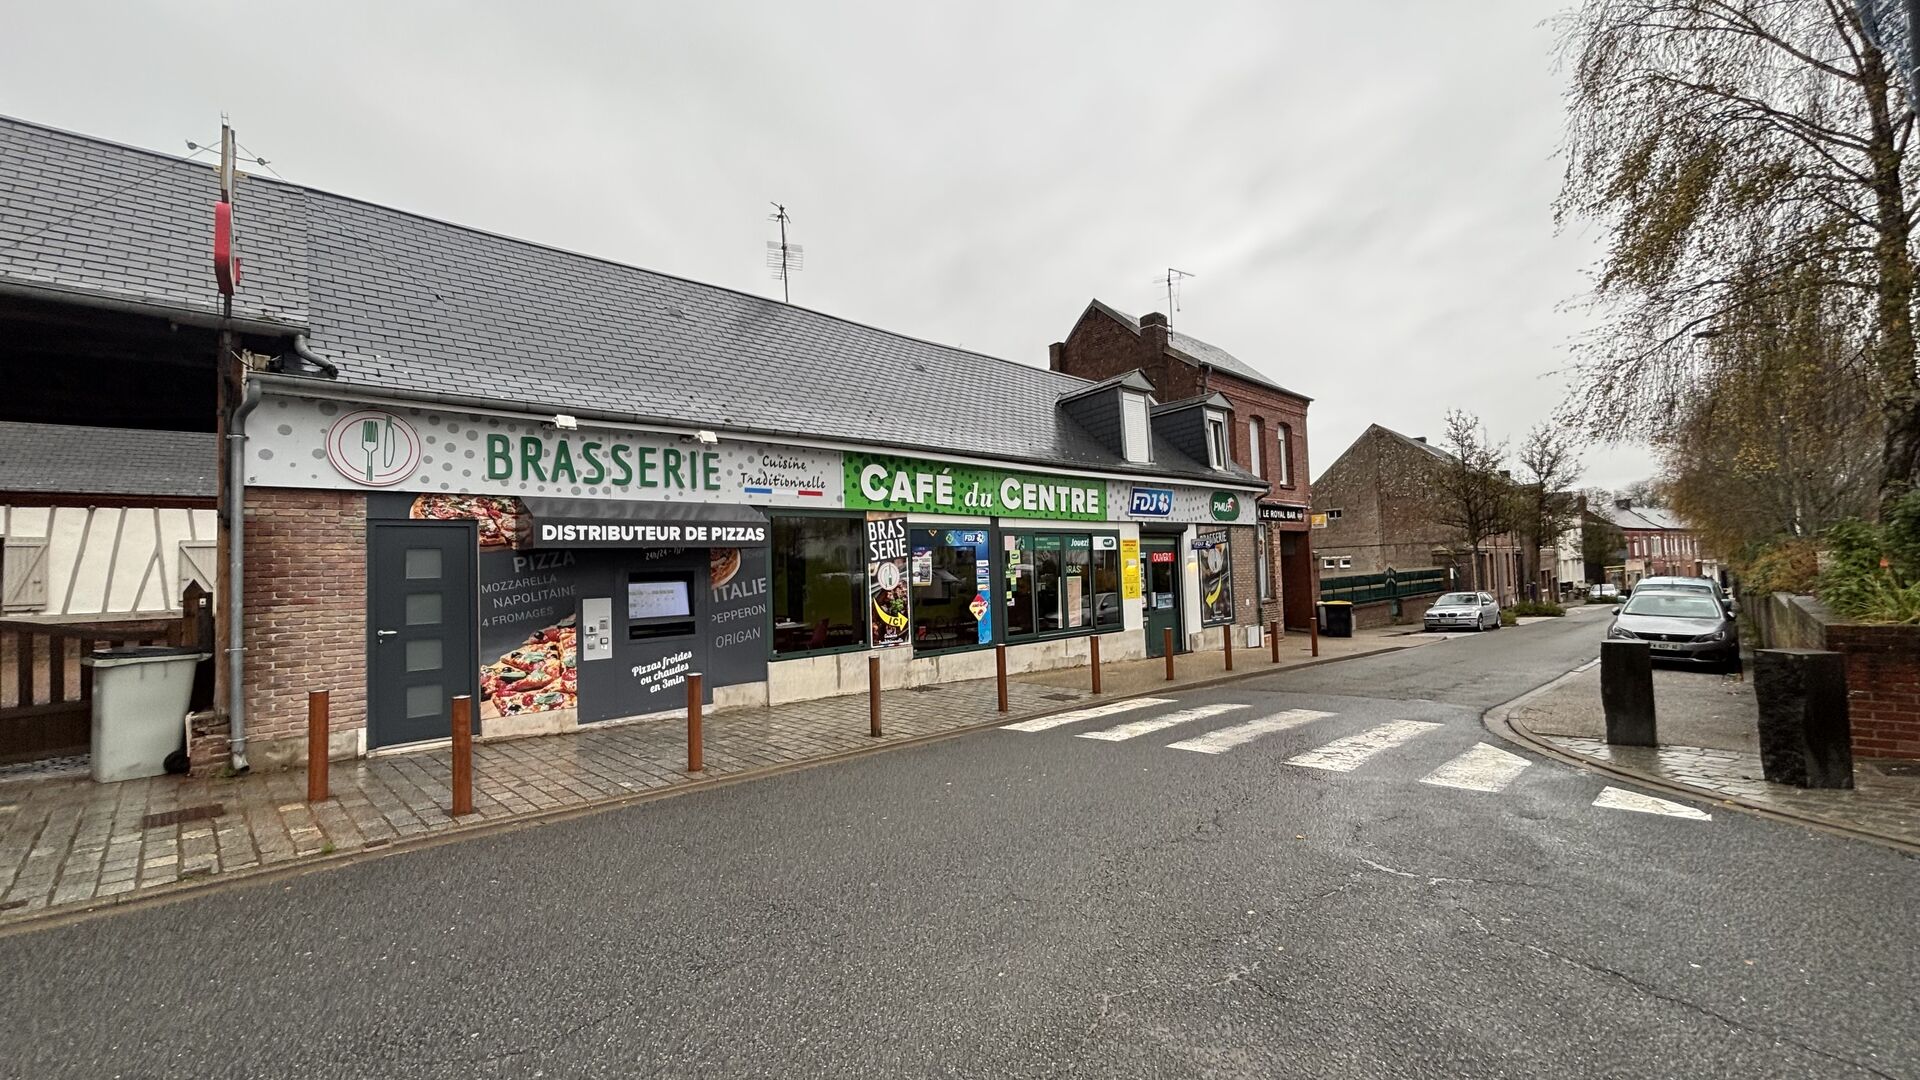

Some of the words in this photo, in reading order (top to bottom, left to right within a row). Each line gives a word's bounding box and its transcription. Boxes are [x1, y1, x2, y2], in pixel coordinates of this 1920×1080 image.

[487, 433, 721, 491] BRASSERIE
[762, 455, 807, 471] Cuisine
[741, 471, 826, 489] Traditionnelle
[860, 463, 953, 505] CAFÉ
[964, 482, 993, 508] du
[1000, 477, 1099, 514] CENTRE
[1132, 492, 1158, 512] FDJ
[1213, 501, 1229, 512] PMU
[1262, 509, 1270, 518] LE
[1270, 510, 1286, 519] ROYAL
[1286, 511, 1296, 519] BAR
[542, 525, 681, 542] DISTRIBUTEUR
[685, 526, 708, 541] DE
[711, 527, 766, 542] PIZZAS
[868, 519, 906, 541] BRAS
[964, 534, 975, 542] FDJ
[870, 538, 908, 561] SERIE
[1071, 538, 1090, 547] Jouez!
[513, 550, 576, 573] PIZZA
[1153, 552, 1173, 562] OUVERT
[481, 573, 558, 594] MOZZARELLA
[481, 618, 489, 628] 4
[492, 606, 554, 626] FROMAGES
[888, 617, 903, 626] ICI
[715, 627, 761, 648] ORIGAN
[631, 661, 662, 677] Pizzas
[661, 651, 693, 670] froides
[640, 675, 652, 686] ou
[653, 662, 690, 681] chaudes
[650, 684, 661, 693] en
[662, 675, 685, 689] 3min
